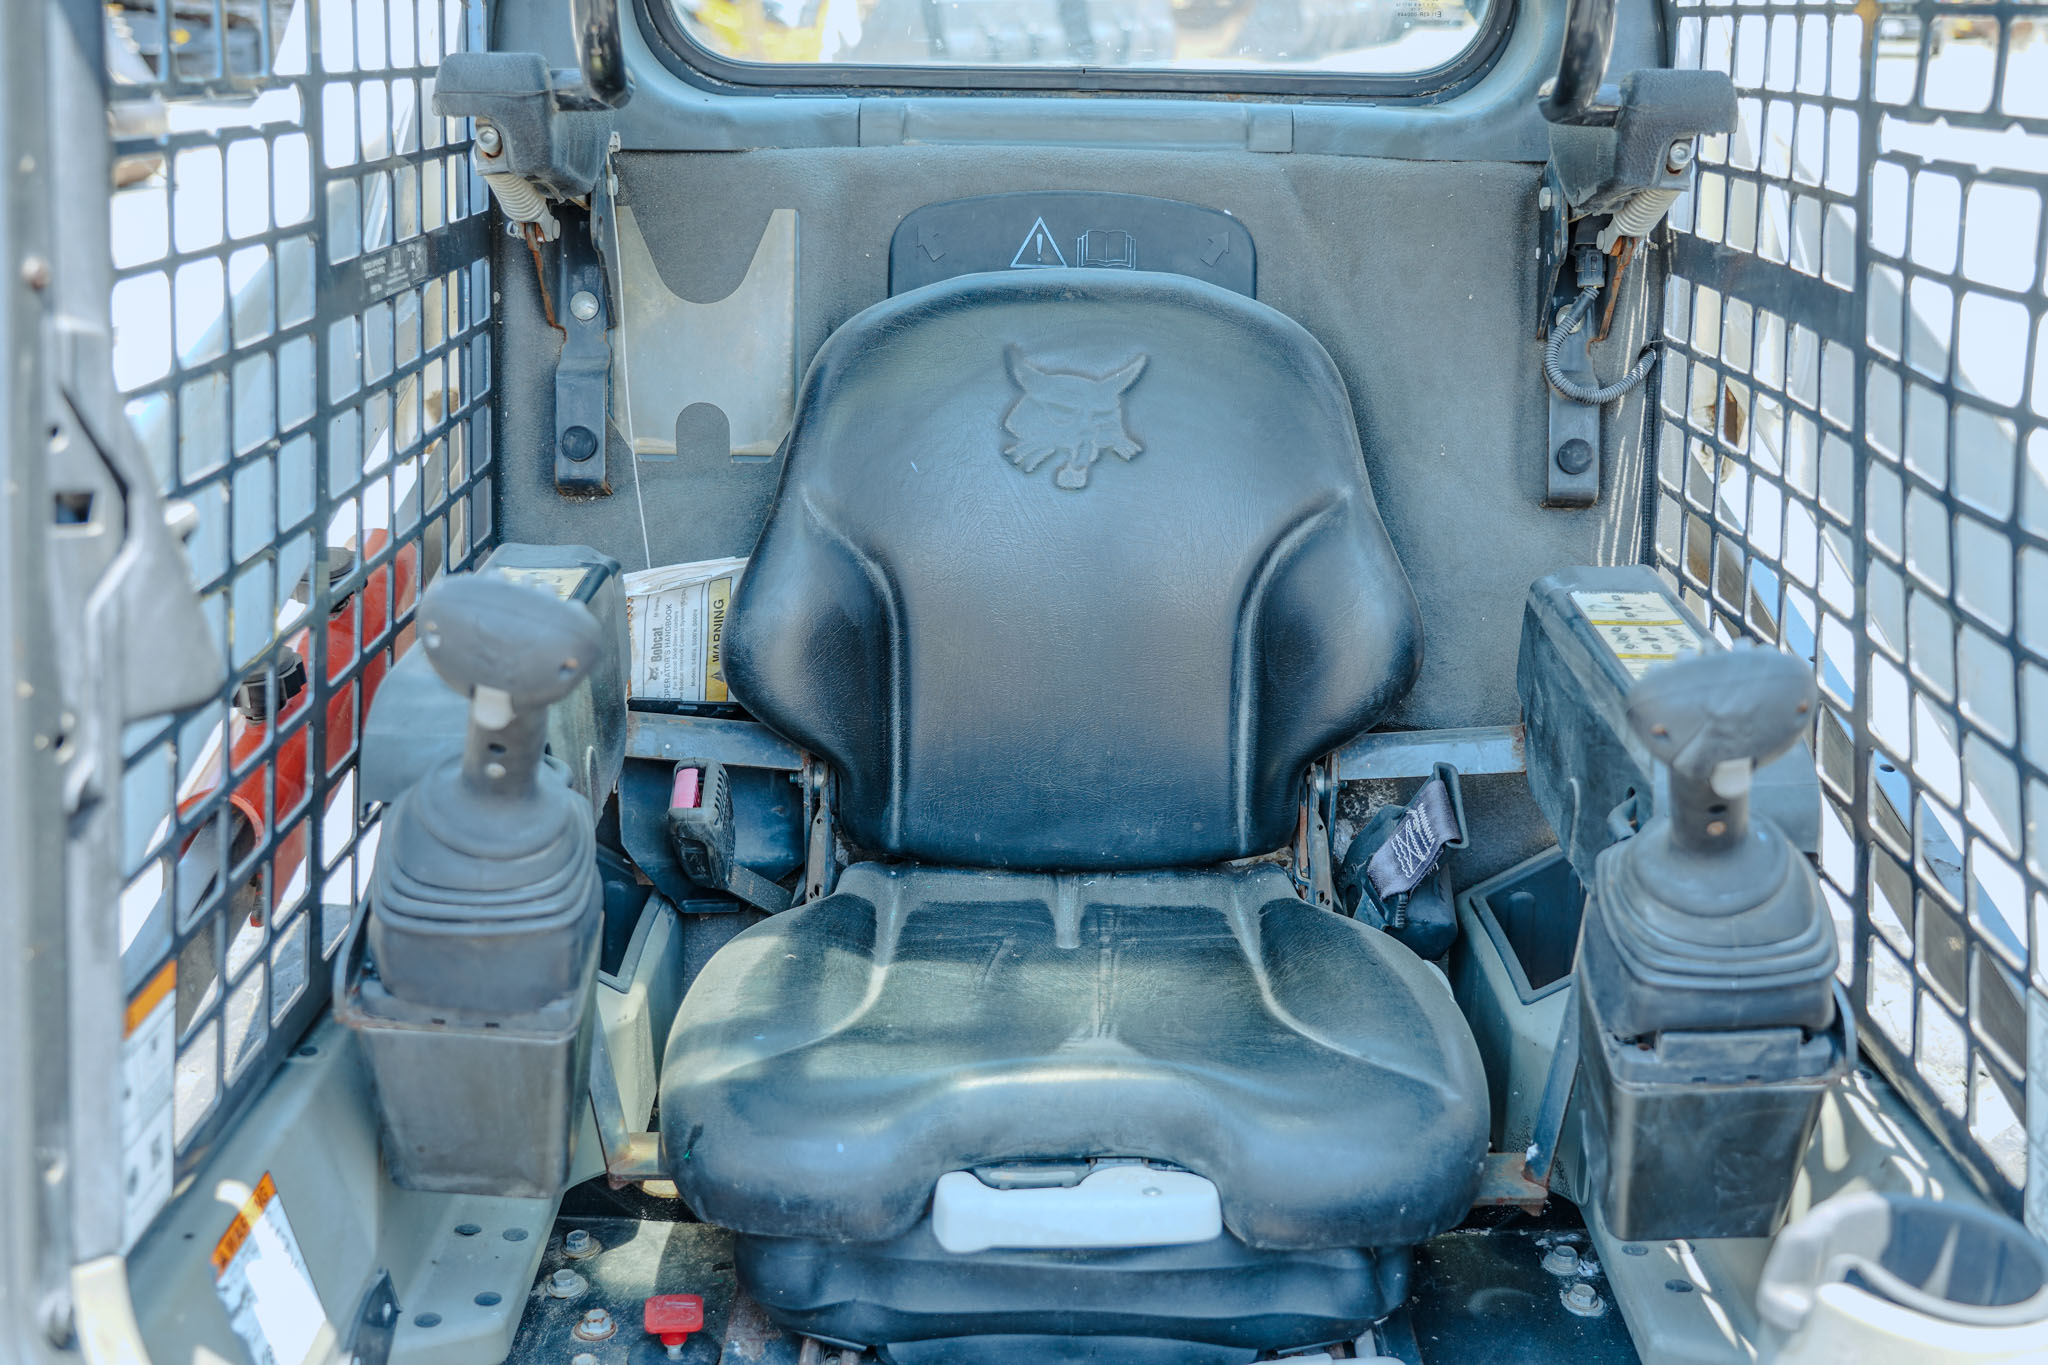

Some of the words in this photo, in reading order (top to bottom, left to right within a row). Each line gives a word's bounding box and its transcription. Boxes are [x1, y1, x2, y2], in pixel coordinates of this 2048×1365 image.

[651, 627, 663, 662] Bobcat
[664, 603, 673, 648] HANDBOOK
[712, 599, 724, 663] WARNING
